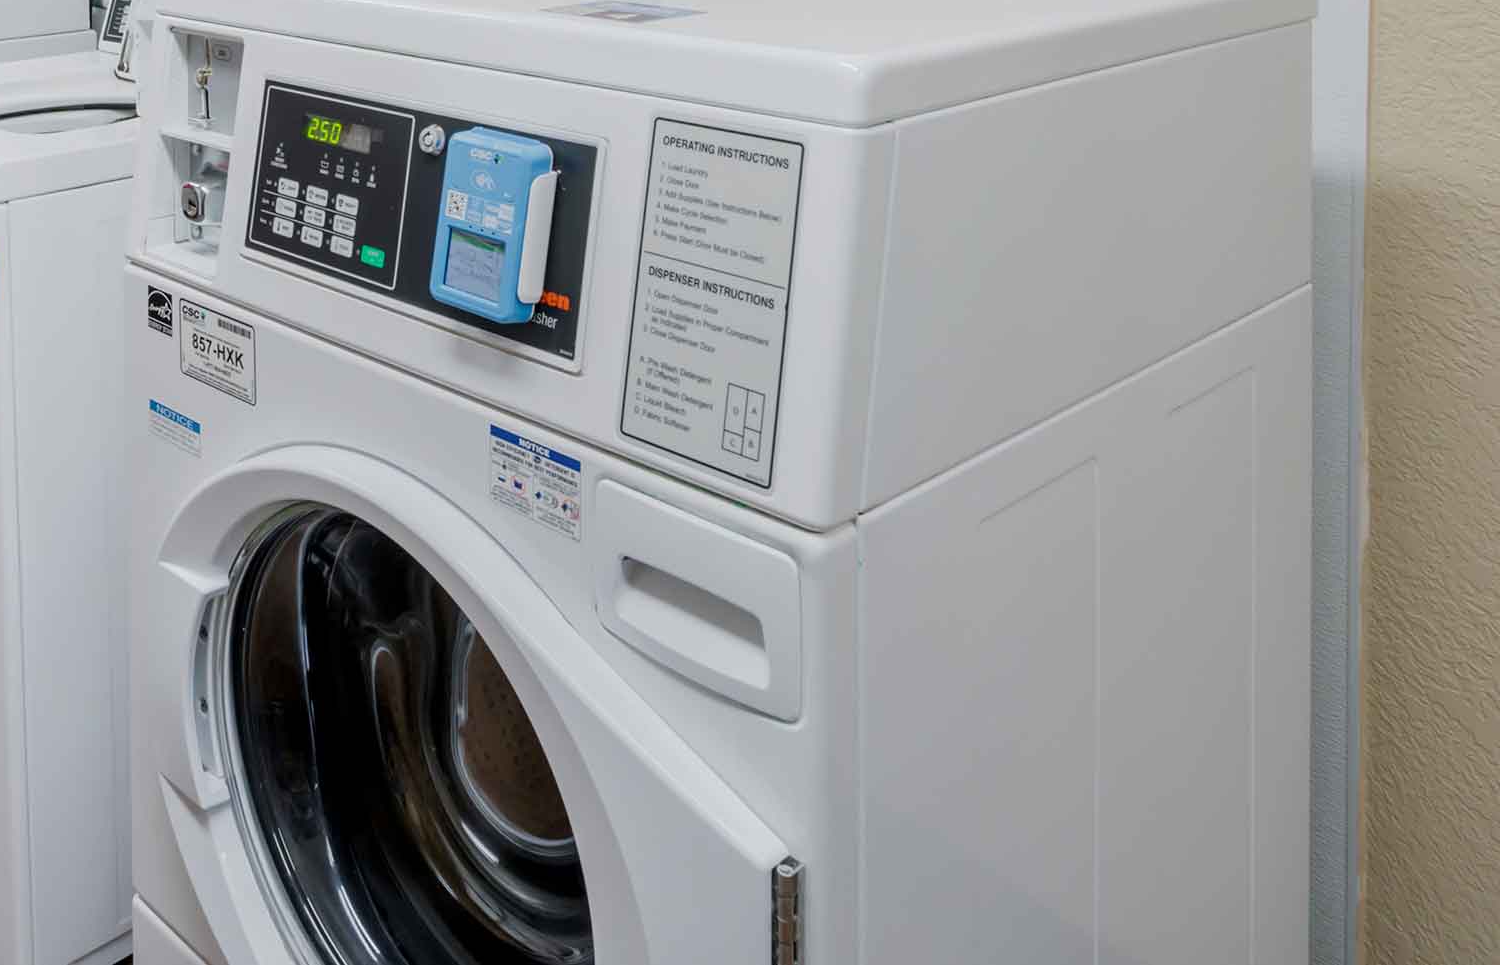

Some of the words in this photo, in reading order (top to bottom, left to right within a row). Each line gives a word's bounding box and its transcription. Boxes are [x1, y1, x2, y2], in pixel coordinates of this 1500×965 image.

[307, 117, 342, 145] 2.50
[662, 136, 715, 154] OPERATING
[717, 147, 789, 169] INSTRUCTIONS
[648, 266, 700, 288] DISPENSER
[702, 282, 774, 310] INSTRUCTIONS
[182, 305, 200, 320] CSC
[192, 333, 244, 370] 857-HXK
[156, 403, 195, 431] NOTICE
[519, 437, 550, 458] NOTICE
